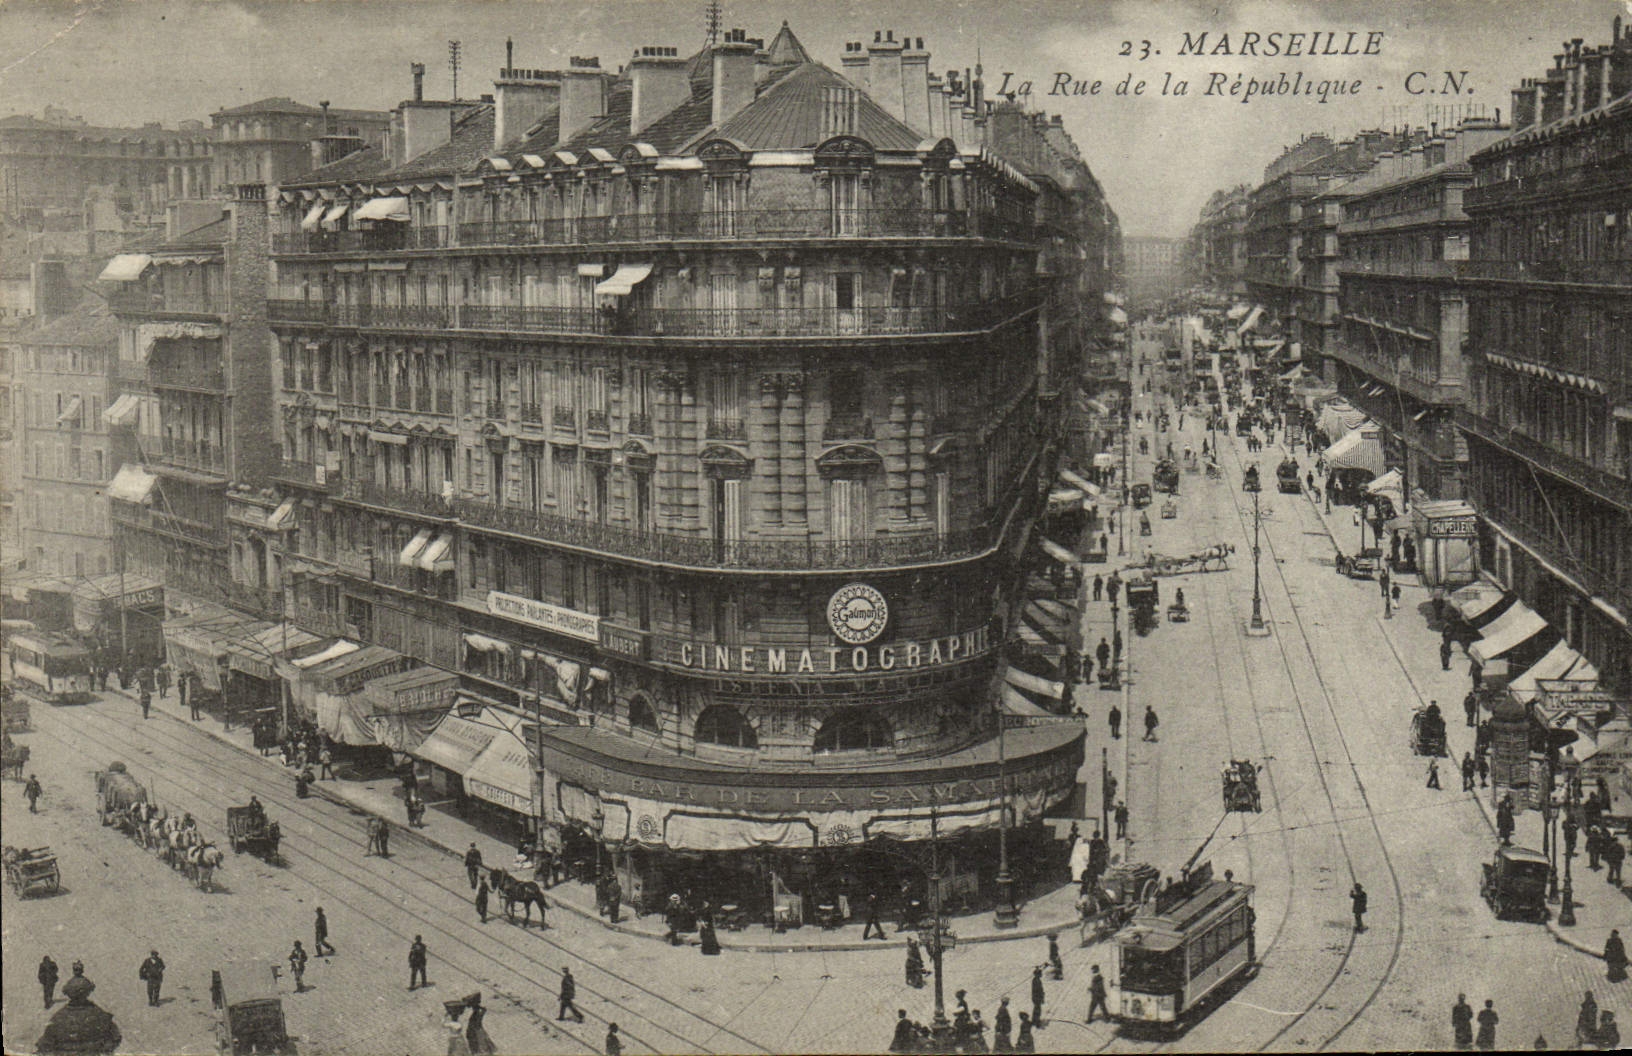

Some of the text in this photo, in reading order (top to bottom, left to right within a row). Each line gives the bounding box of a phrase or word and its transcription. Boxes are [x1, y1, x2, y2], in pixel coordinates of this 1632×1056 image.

[838, 606, 881, 624] Gaumont
[631, 779, 697, 800] BAR
[718, 789, 770, 805] DE
[792, 788, 847, 806] LA
